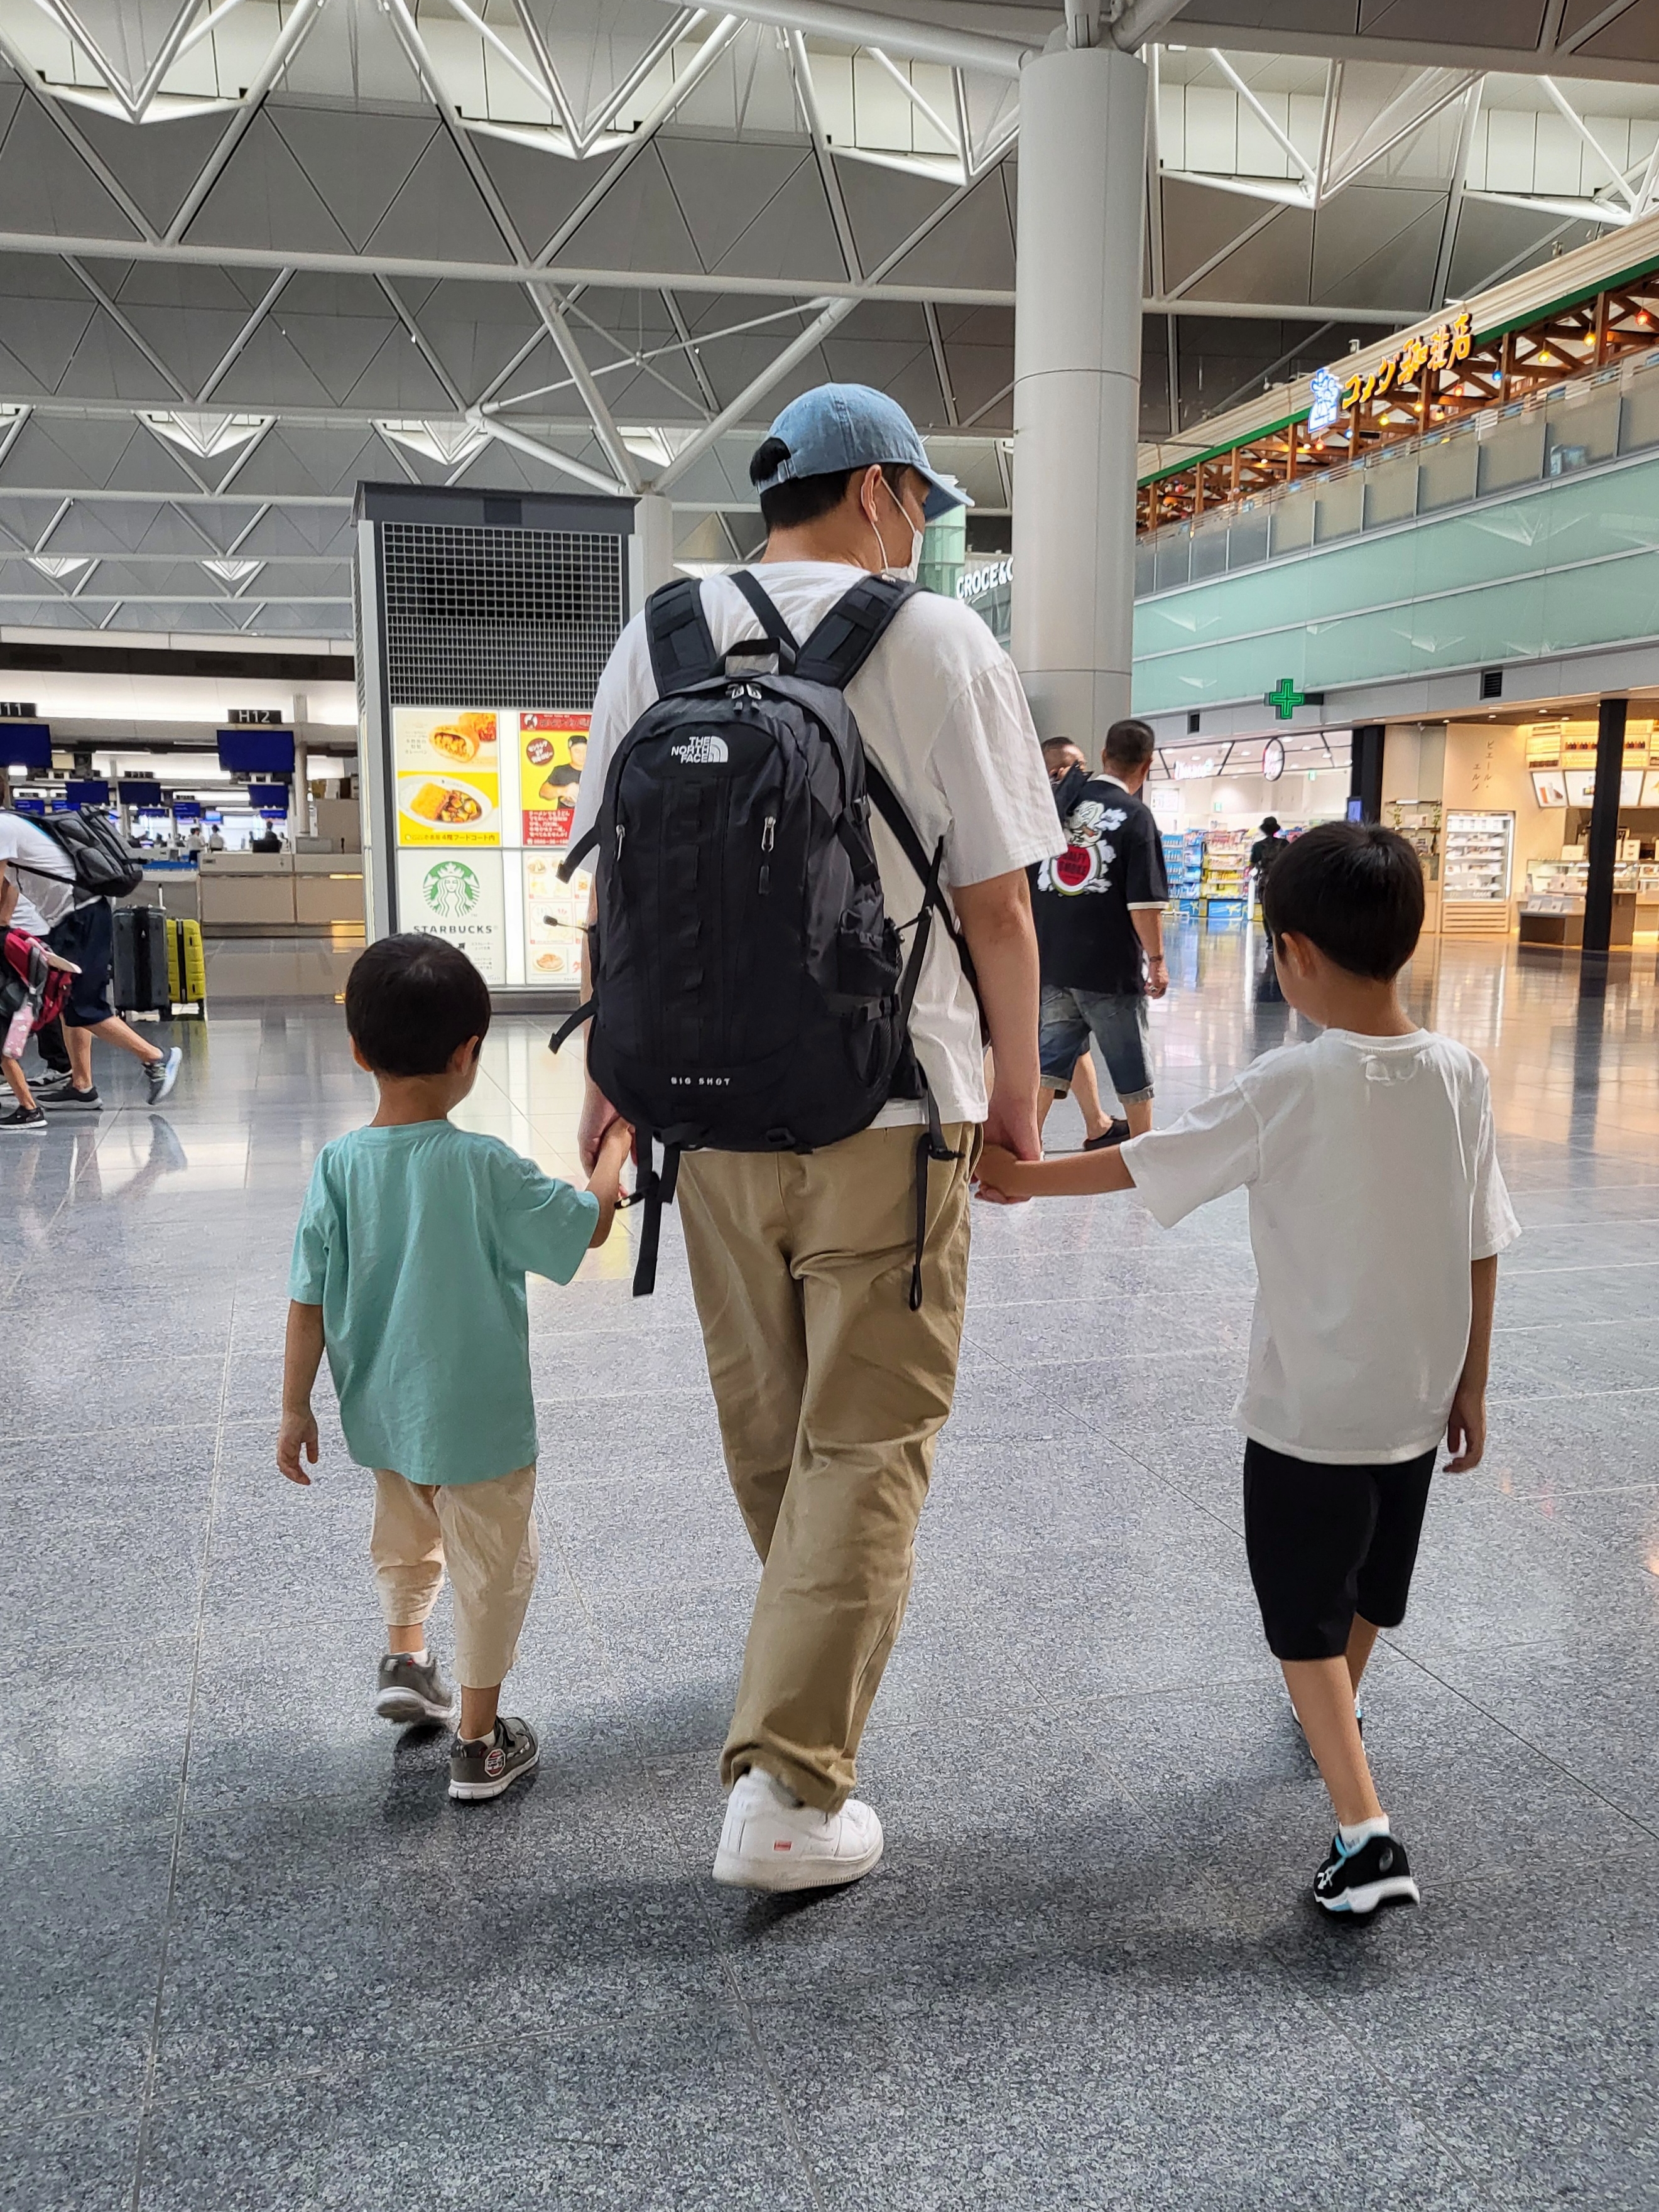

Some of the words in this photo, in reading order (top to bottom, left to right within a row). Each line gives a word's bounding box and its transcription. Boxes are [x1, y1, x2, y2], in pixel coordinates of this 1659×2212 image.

[1342, 312, 1471, 410] コメダ珈琲店
[0, 703, 22, 716] 11
[239, 710, 270, 723] H12
[689, 736, 710, 747] THE
[671, 745, 709, 756] NORTH
[680, 753, 708, 764] FACE
[413, 925, 492, 935] STARBUCKS
[671, 1076, 691, 1085] BIG
[699, 1077, 730, 1085] SHOT
